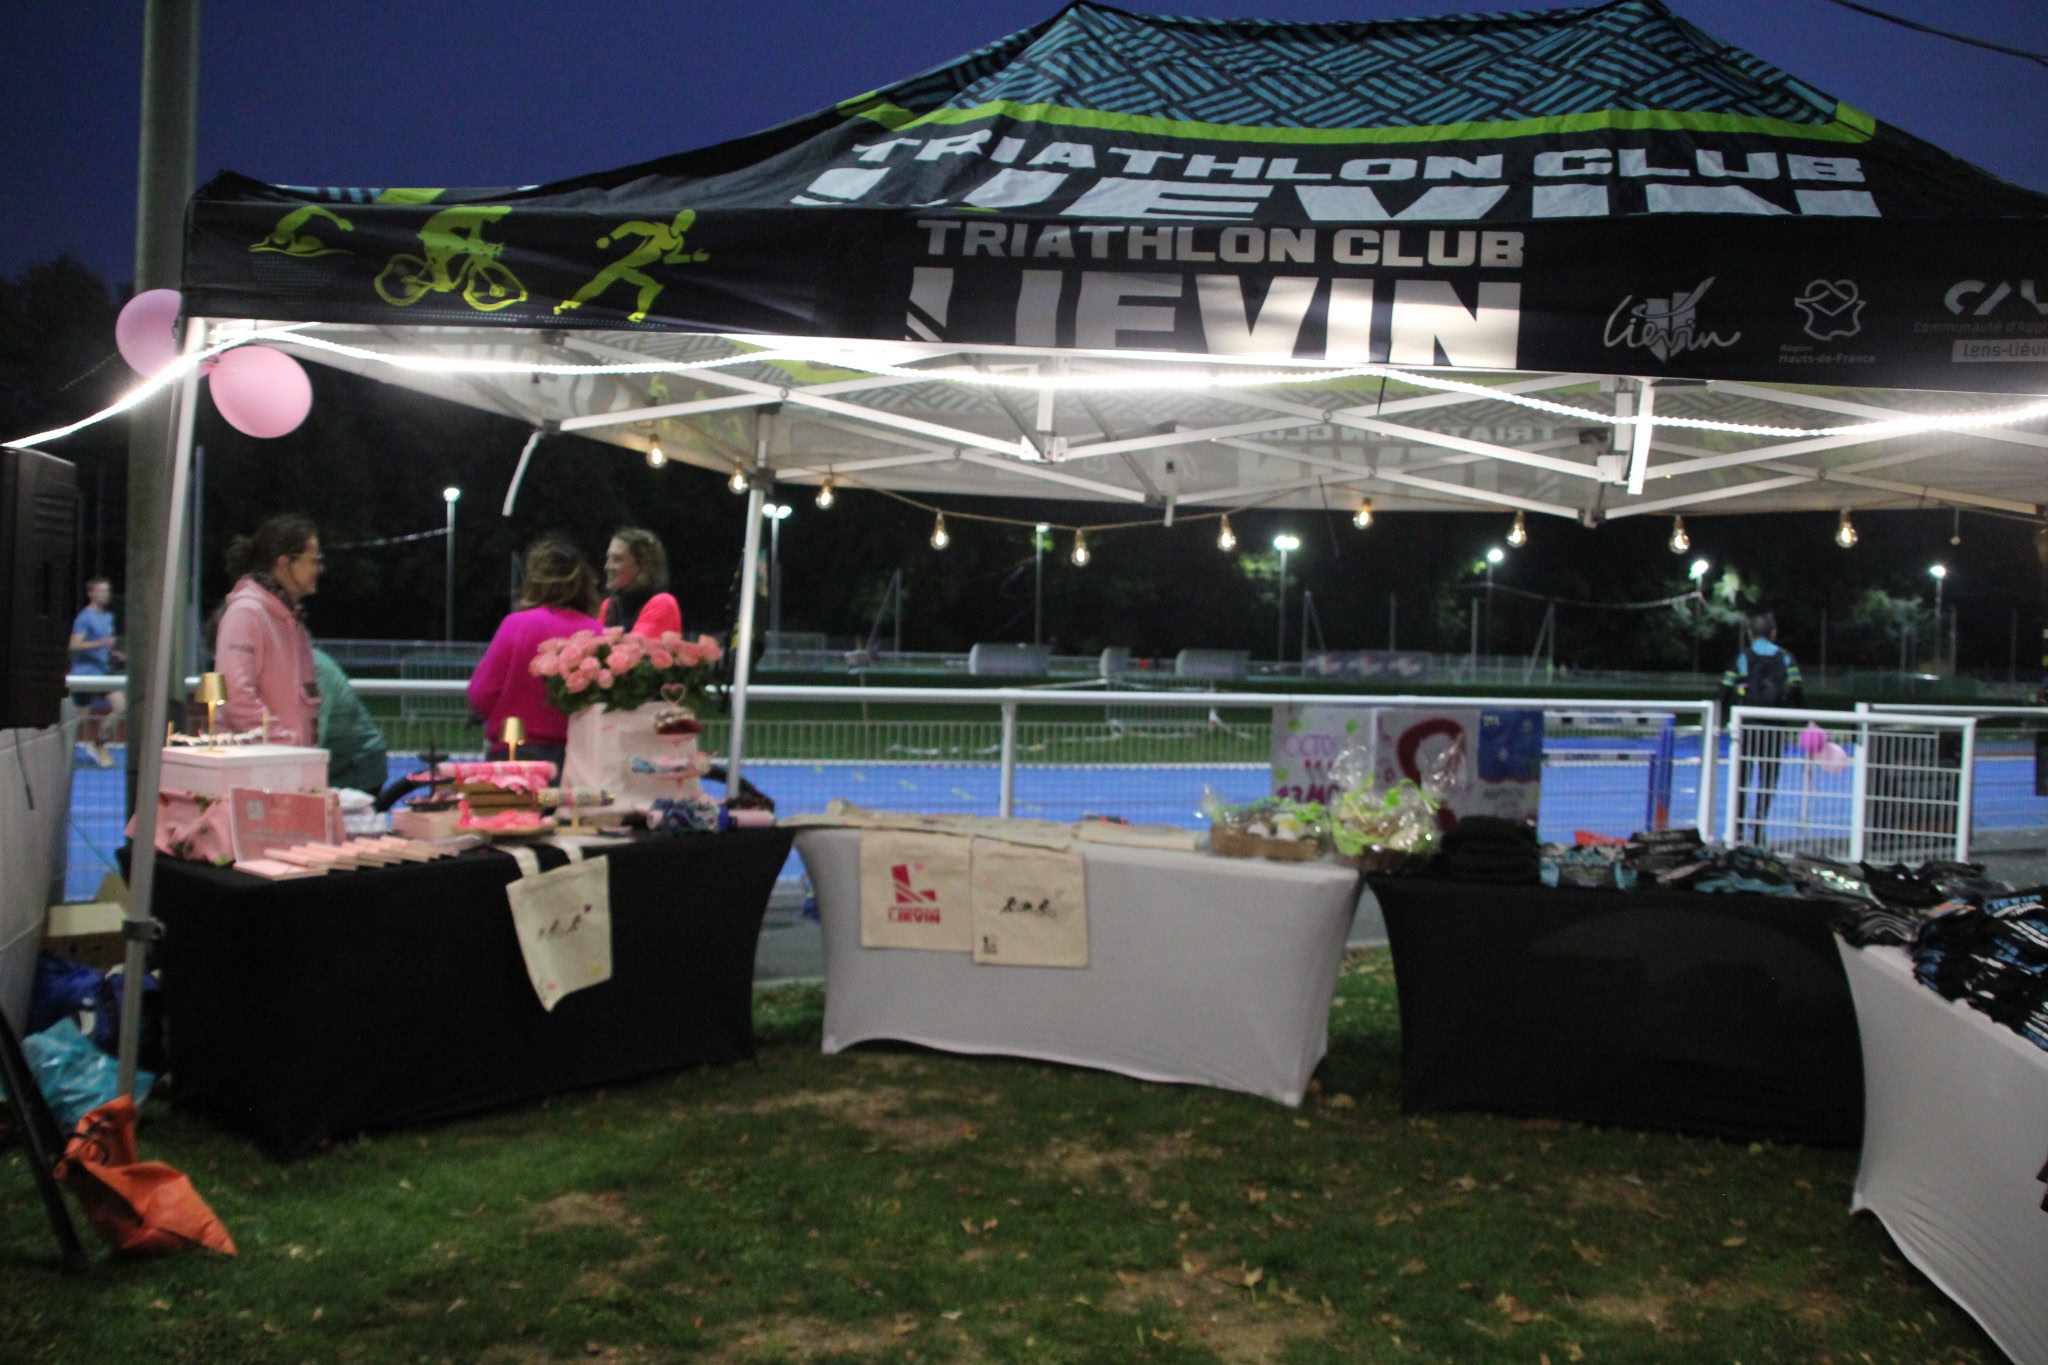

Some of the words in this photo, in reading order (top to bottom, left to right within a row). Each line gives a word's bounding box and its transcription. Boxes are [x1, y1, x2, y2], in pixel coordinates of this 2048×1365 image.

[852, 129, 1504, 181] TRIATHLON
[1533, 148, 1866, 183] CLUB
[916, 219, 1317, 264] TRIATHLON
[1332, 228, 1525, 268] CLUB
